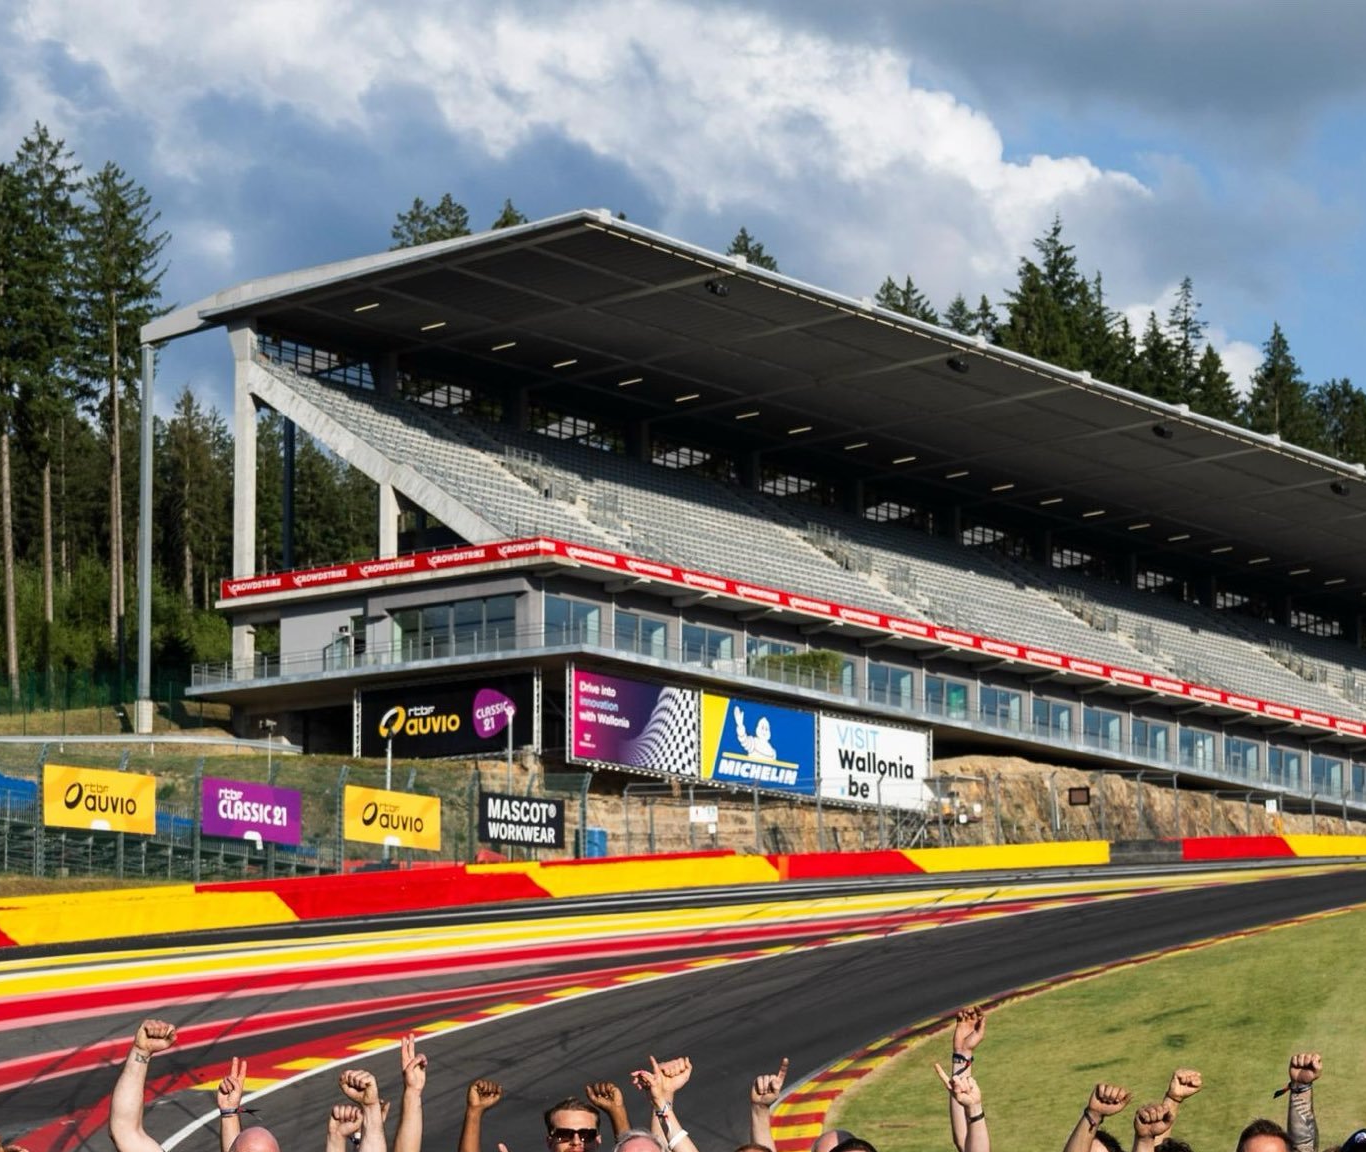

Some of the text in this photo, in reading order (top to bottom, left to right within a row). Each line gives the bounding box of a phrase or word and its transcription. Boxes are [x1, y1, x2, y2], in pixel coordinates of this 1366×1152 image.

[579, 681, 599, 695] Drive
[405, 714, 460, 736] auvio
[483, 719, 495, 732] 21
[598, 713, 630, 729] Wallonia
[836, 724, 879, 750] VISIT
[718, 759, 798, 786] MICHELIN
[838, 749, 914, 780] Wallonia
[84, 794, 136, 816] auvio
[218, 799, 287, 827] CLASSIC 21
[379, 812, 424, 833] auvio
[488, 821, 555, 844] WORKWEAR
